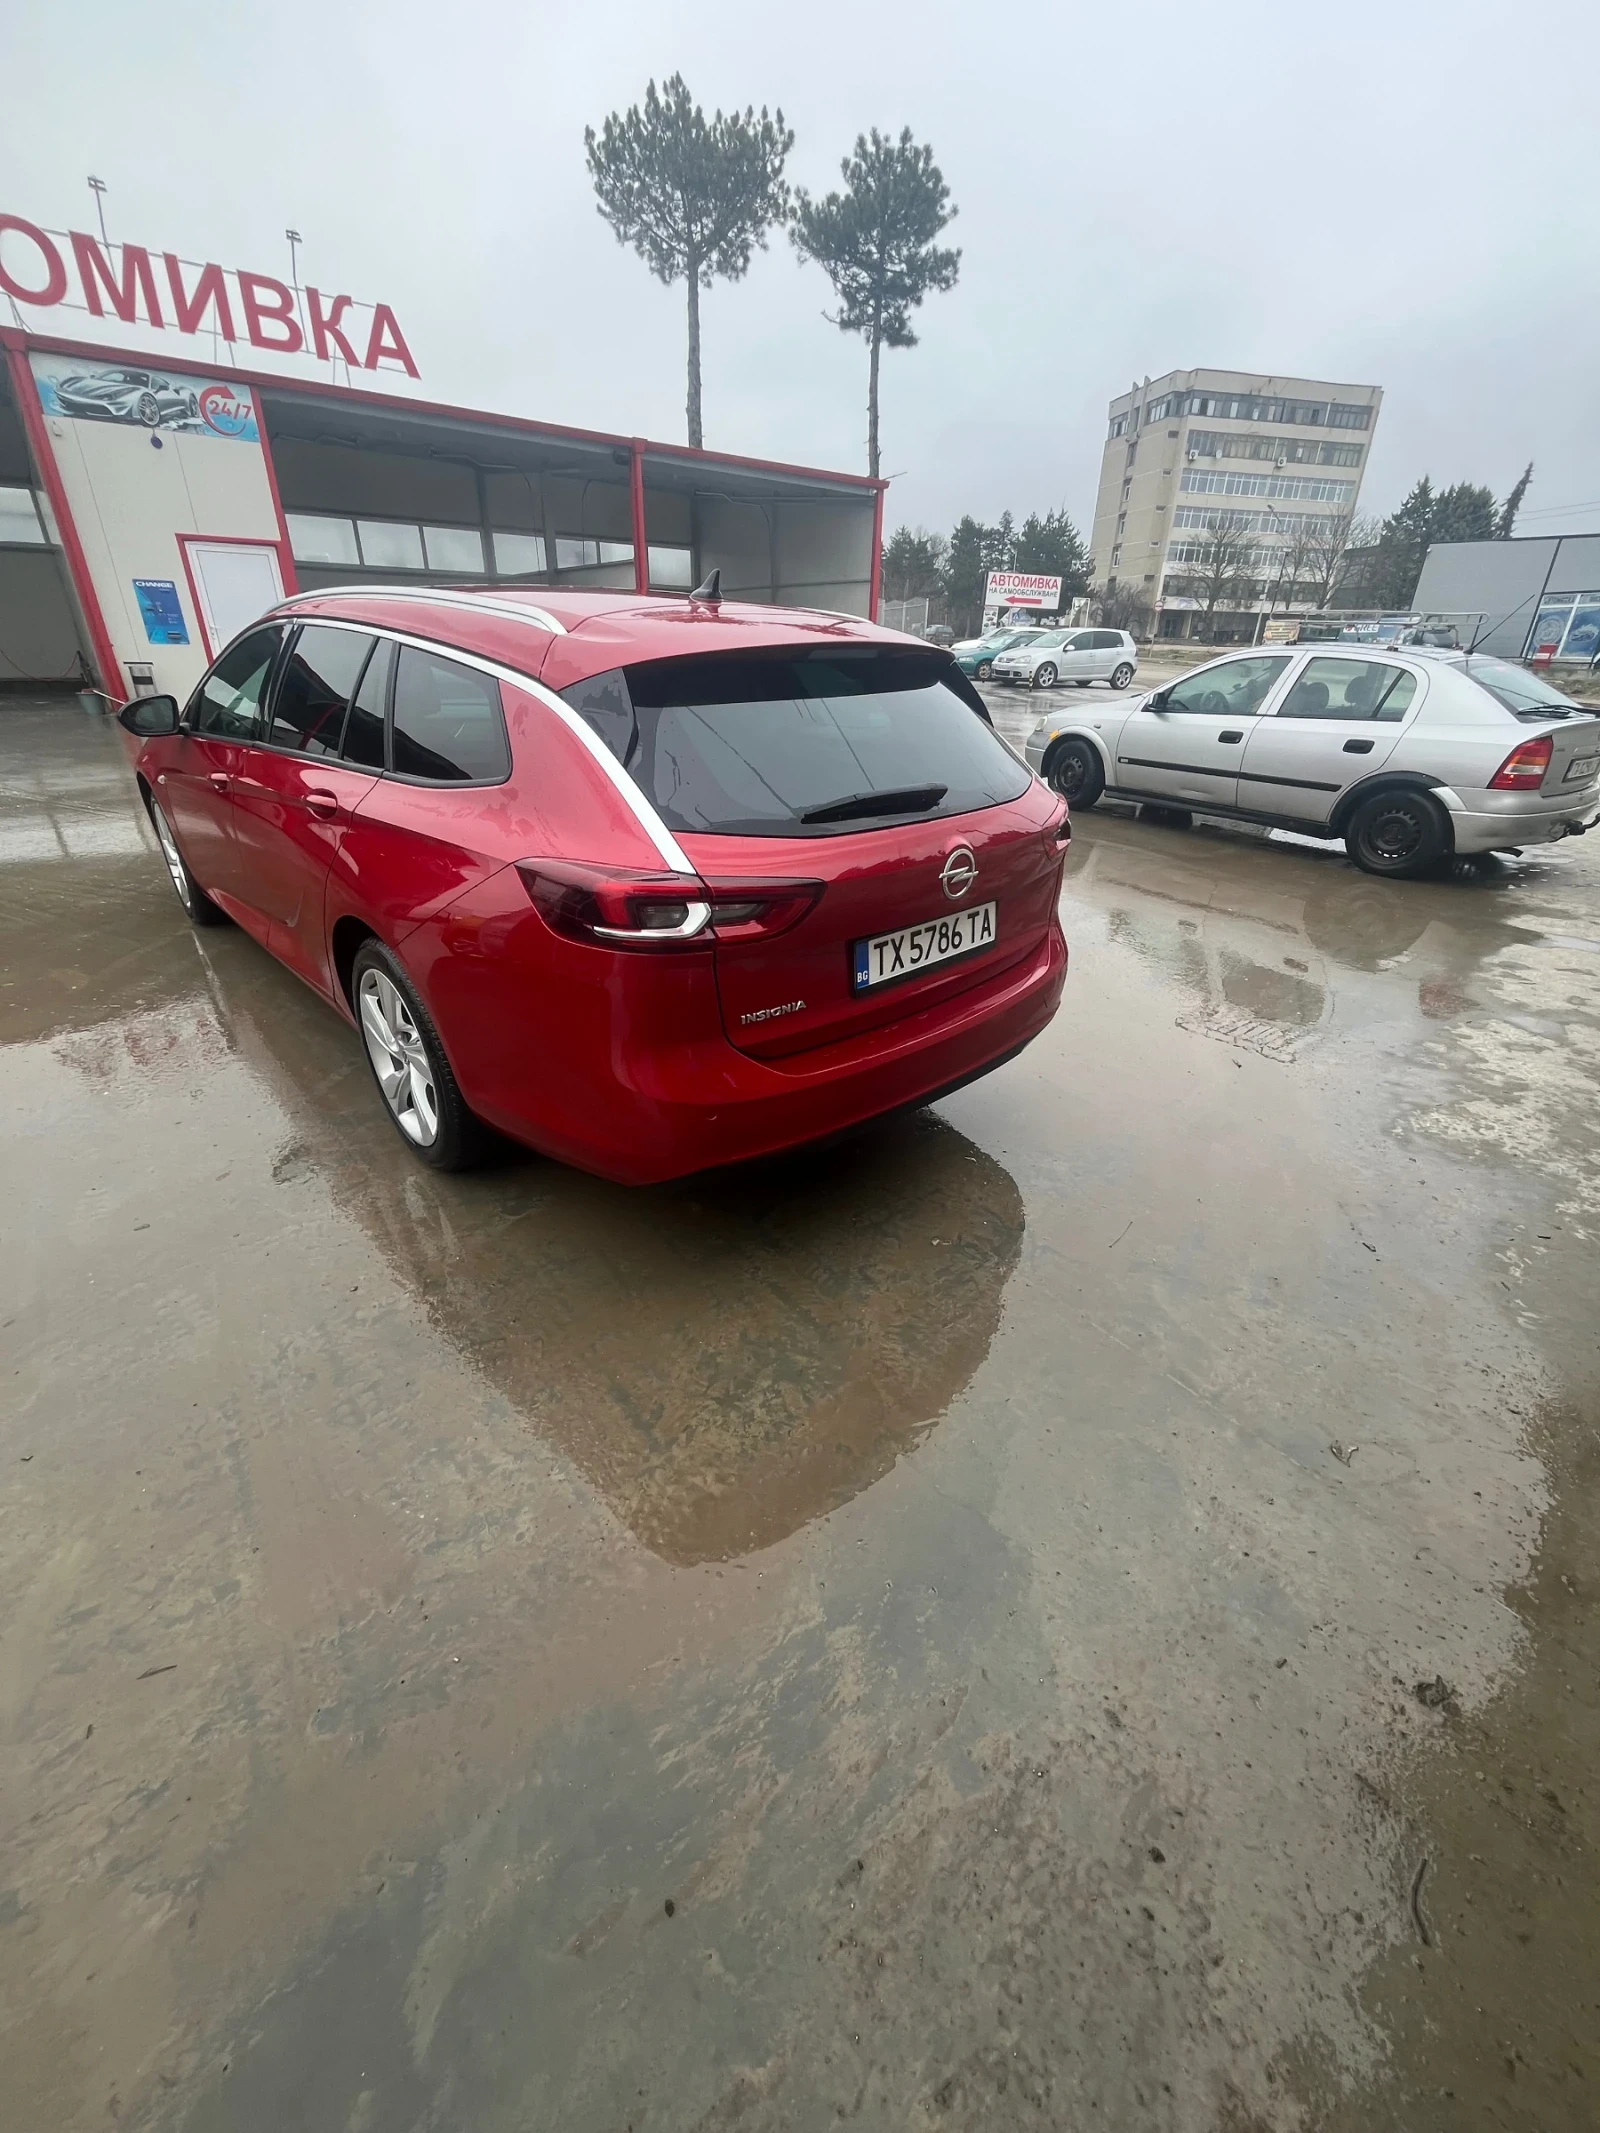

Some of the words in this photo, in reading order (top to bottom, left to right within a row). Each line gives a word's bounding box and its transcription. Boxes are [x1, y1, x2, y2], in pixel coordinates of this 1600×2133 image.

[0, 213, 422, 380] ОМИВКА
[208, 399, 252, 420] 24/7
[989, 573, 1059, 590] АВТОМИВКА
[999, 587, 1058, 598] САМООБСЛУЖВАНЕ
[856, 970, 869, 984] BG
[741, 1000, 807, 1025] INSIGNIA
